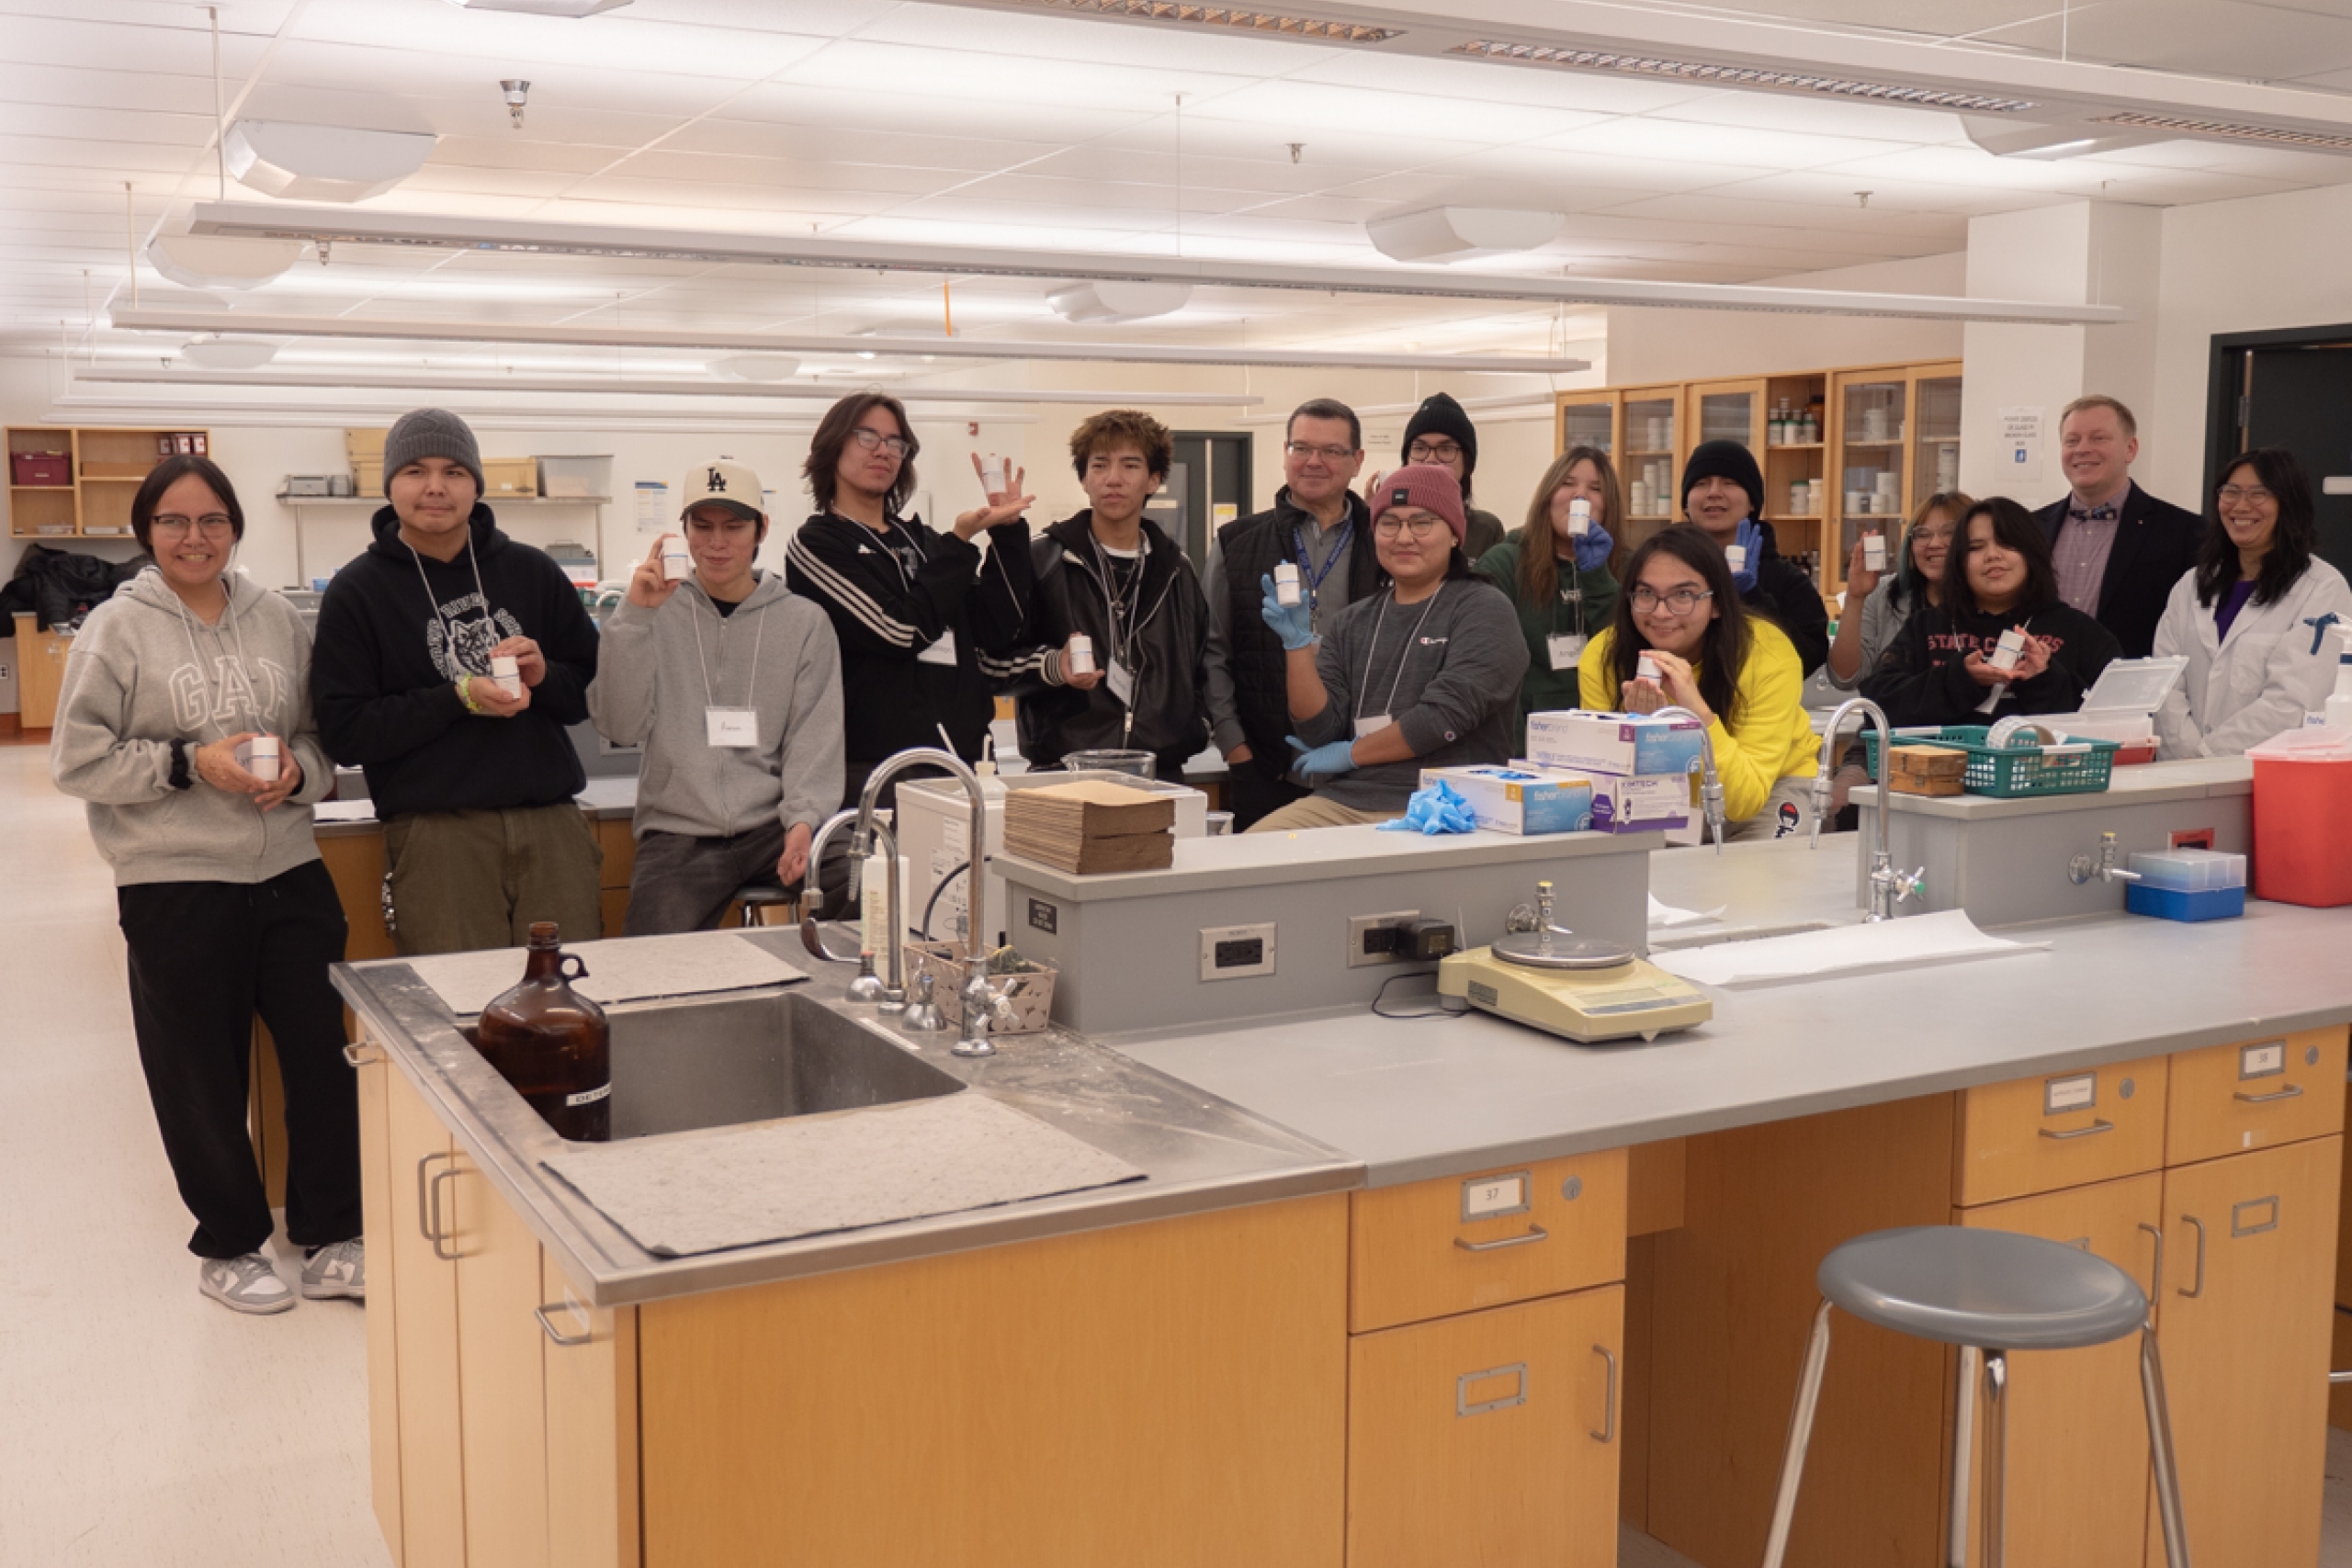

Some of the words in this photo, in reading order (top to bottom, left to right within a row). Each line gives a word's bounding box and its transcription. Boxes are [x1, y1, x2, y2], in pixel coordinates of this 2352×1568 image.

[707, 467, 727, 492] LA
[1928, 633, 1980, 650] STATE
[1486, 1188, 1499, 1201] 37
